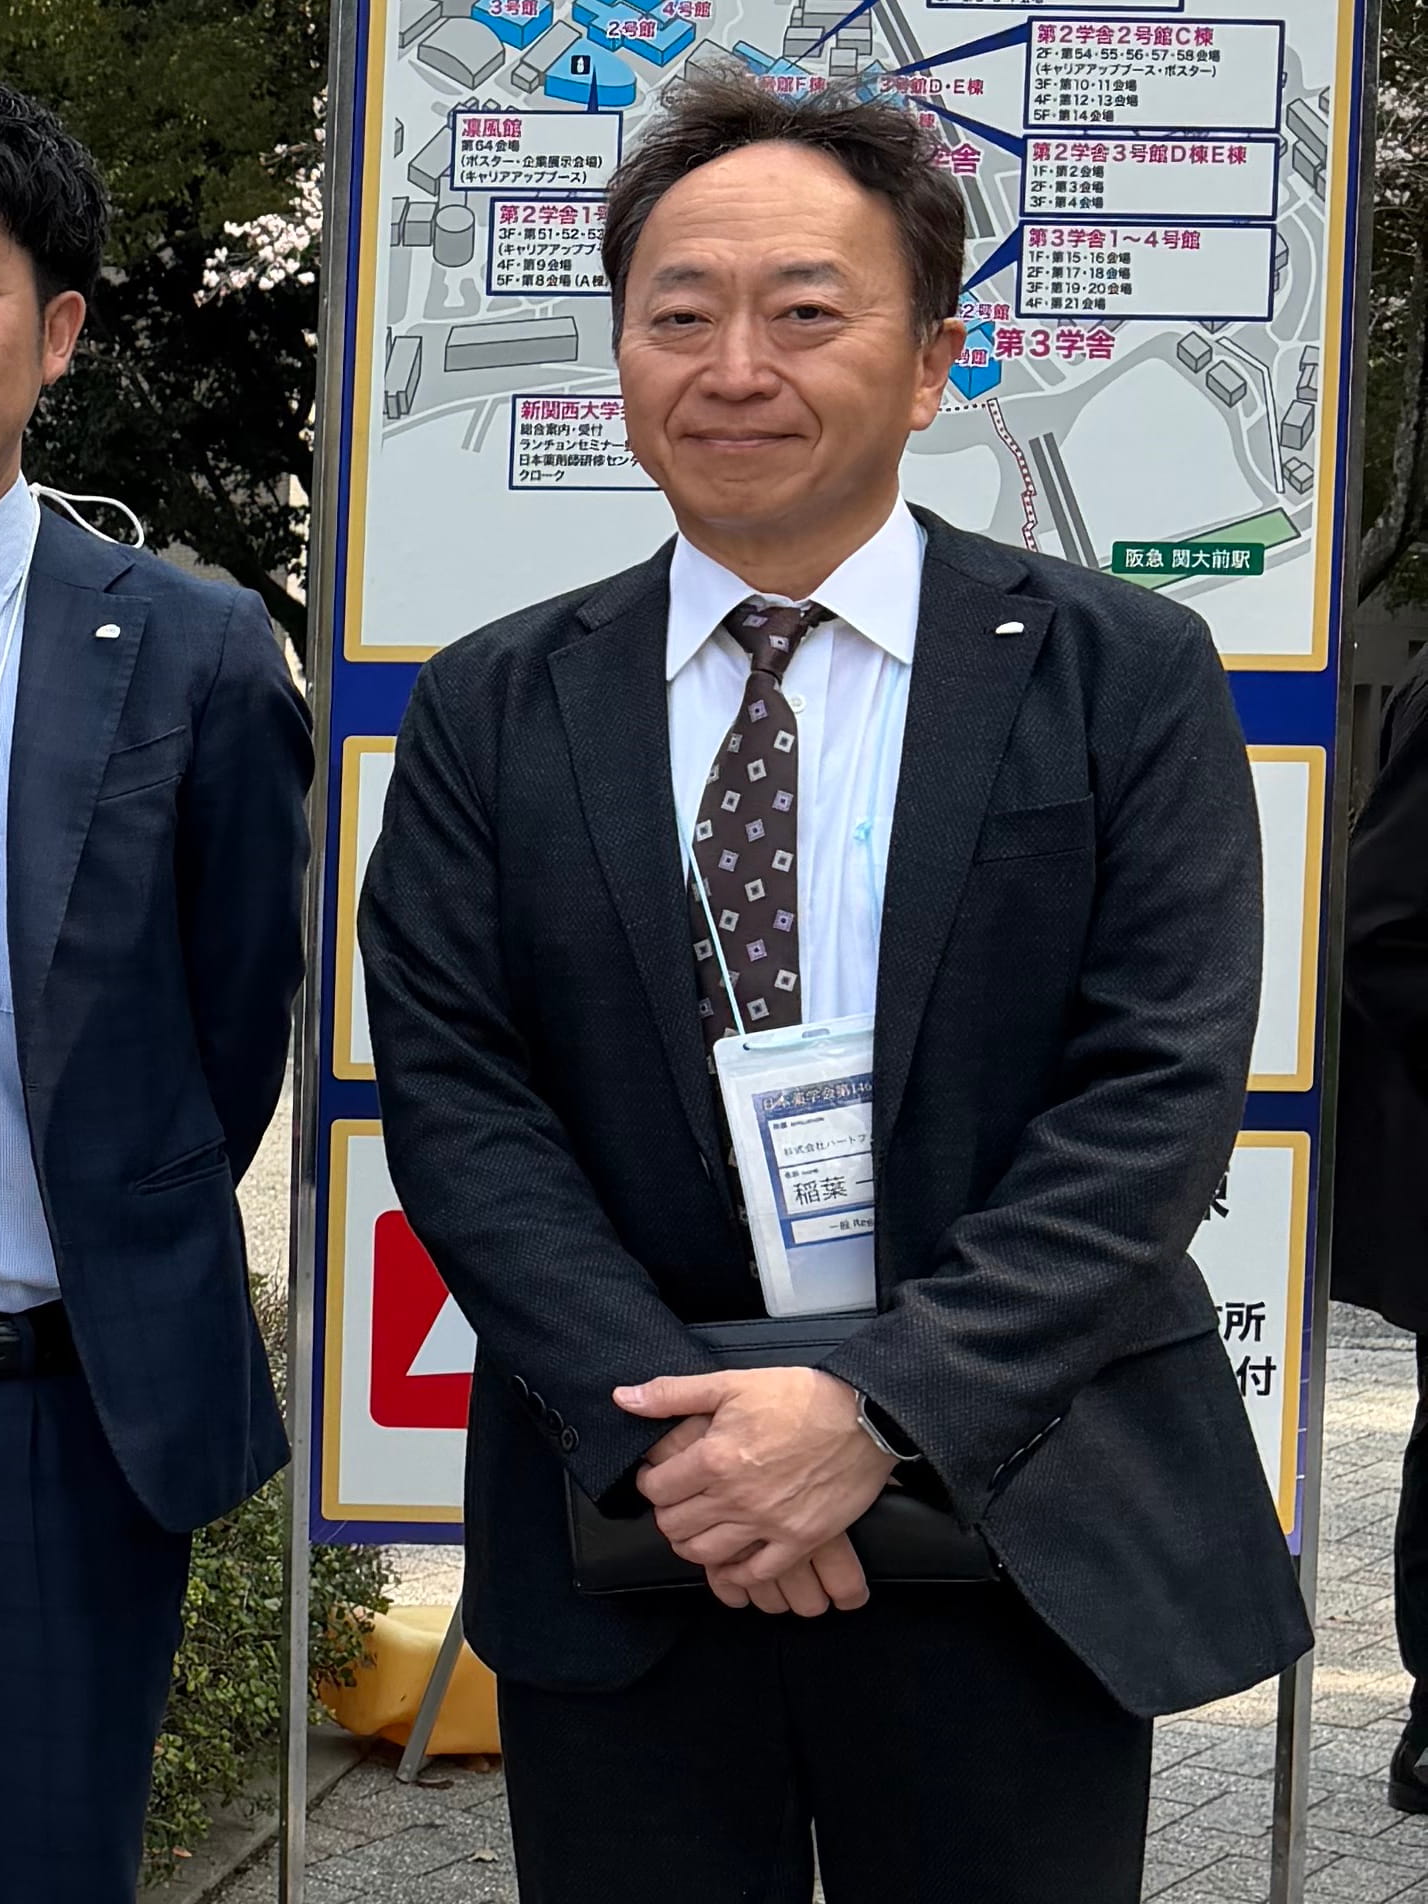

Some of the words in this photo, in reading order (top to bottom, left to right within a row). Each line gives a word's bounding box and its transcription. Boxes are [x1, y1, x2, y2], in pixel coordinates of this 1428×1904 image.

[489, 0, 538, 17] 3号館
[662, 0, 712, 18] 4号館
[608, 20, 657, 38] 2号館
[1037, 24, 1214, 46] 第2学舎2号館C棟
[1032, 142, 1247, 165] 第2学舎3号館D棟E棟
[498, 243, 602, 256] (キャリアアップブ
[1028, 227, 1201, 250] 第3学舎1〜4号館
[994, 327, 1116, 360] 第3学舎
[519, 469, 565, 482] クローク
[1125, 547, 1165, 569] 阪急
[1171, 548, 1252, 570] 関大前駅
[793, 1175, 848, 1207] 稲葉
[1214, 1300, 1266, 1343] 所
